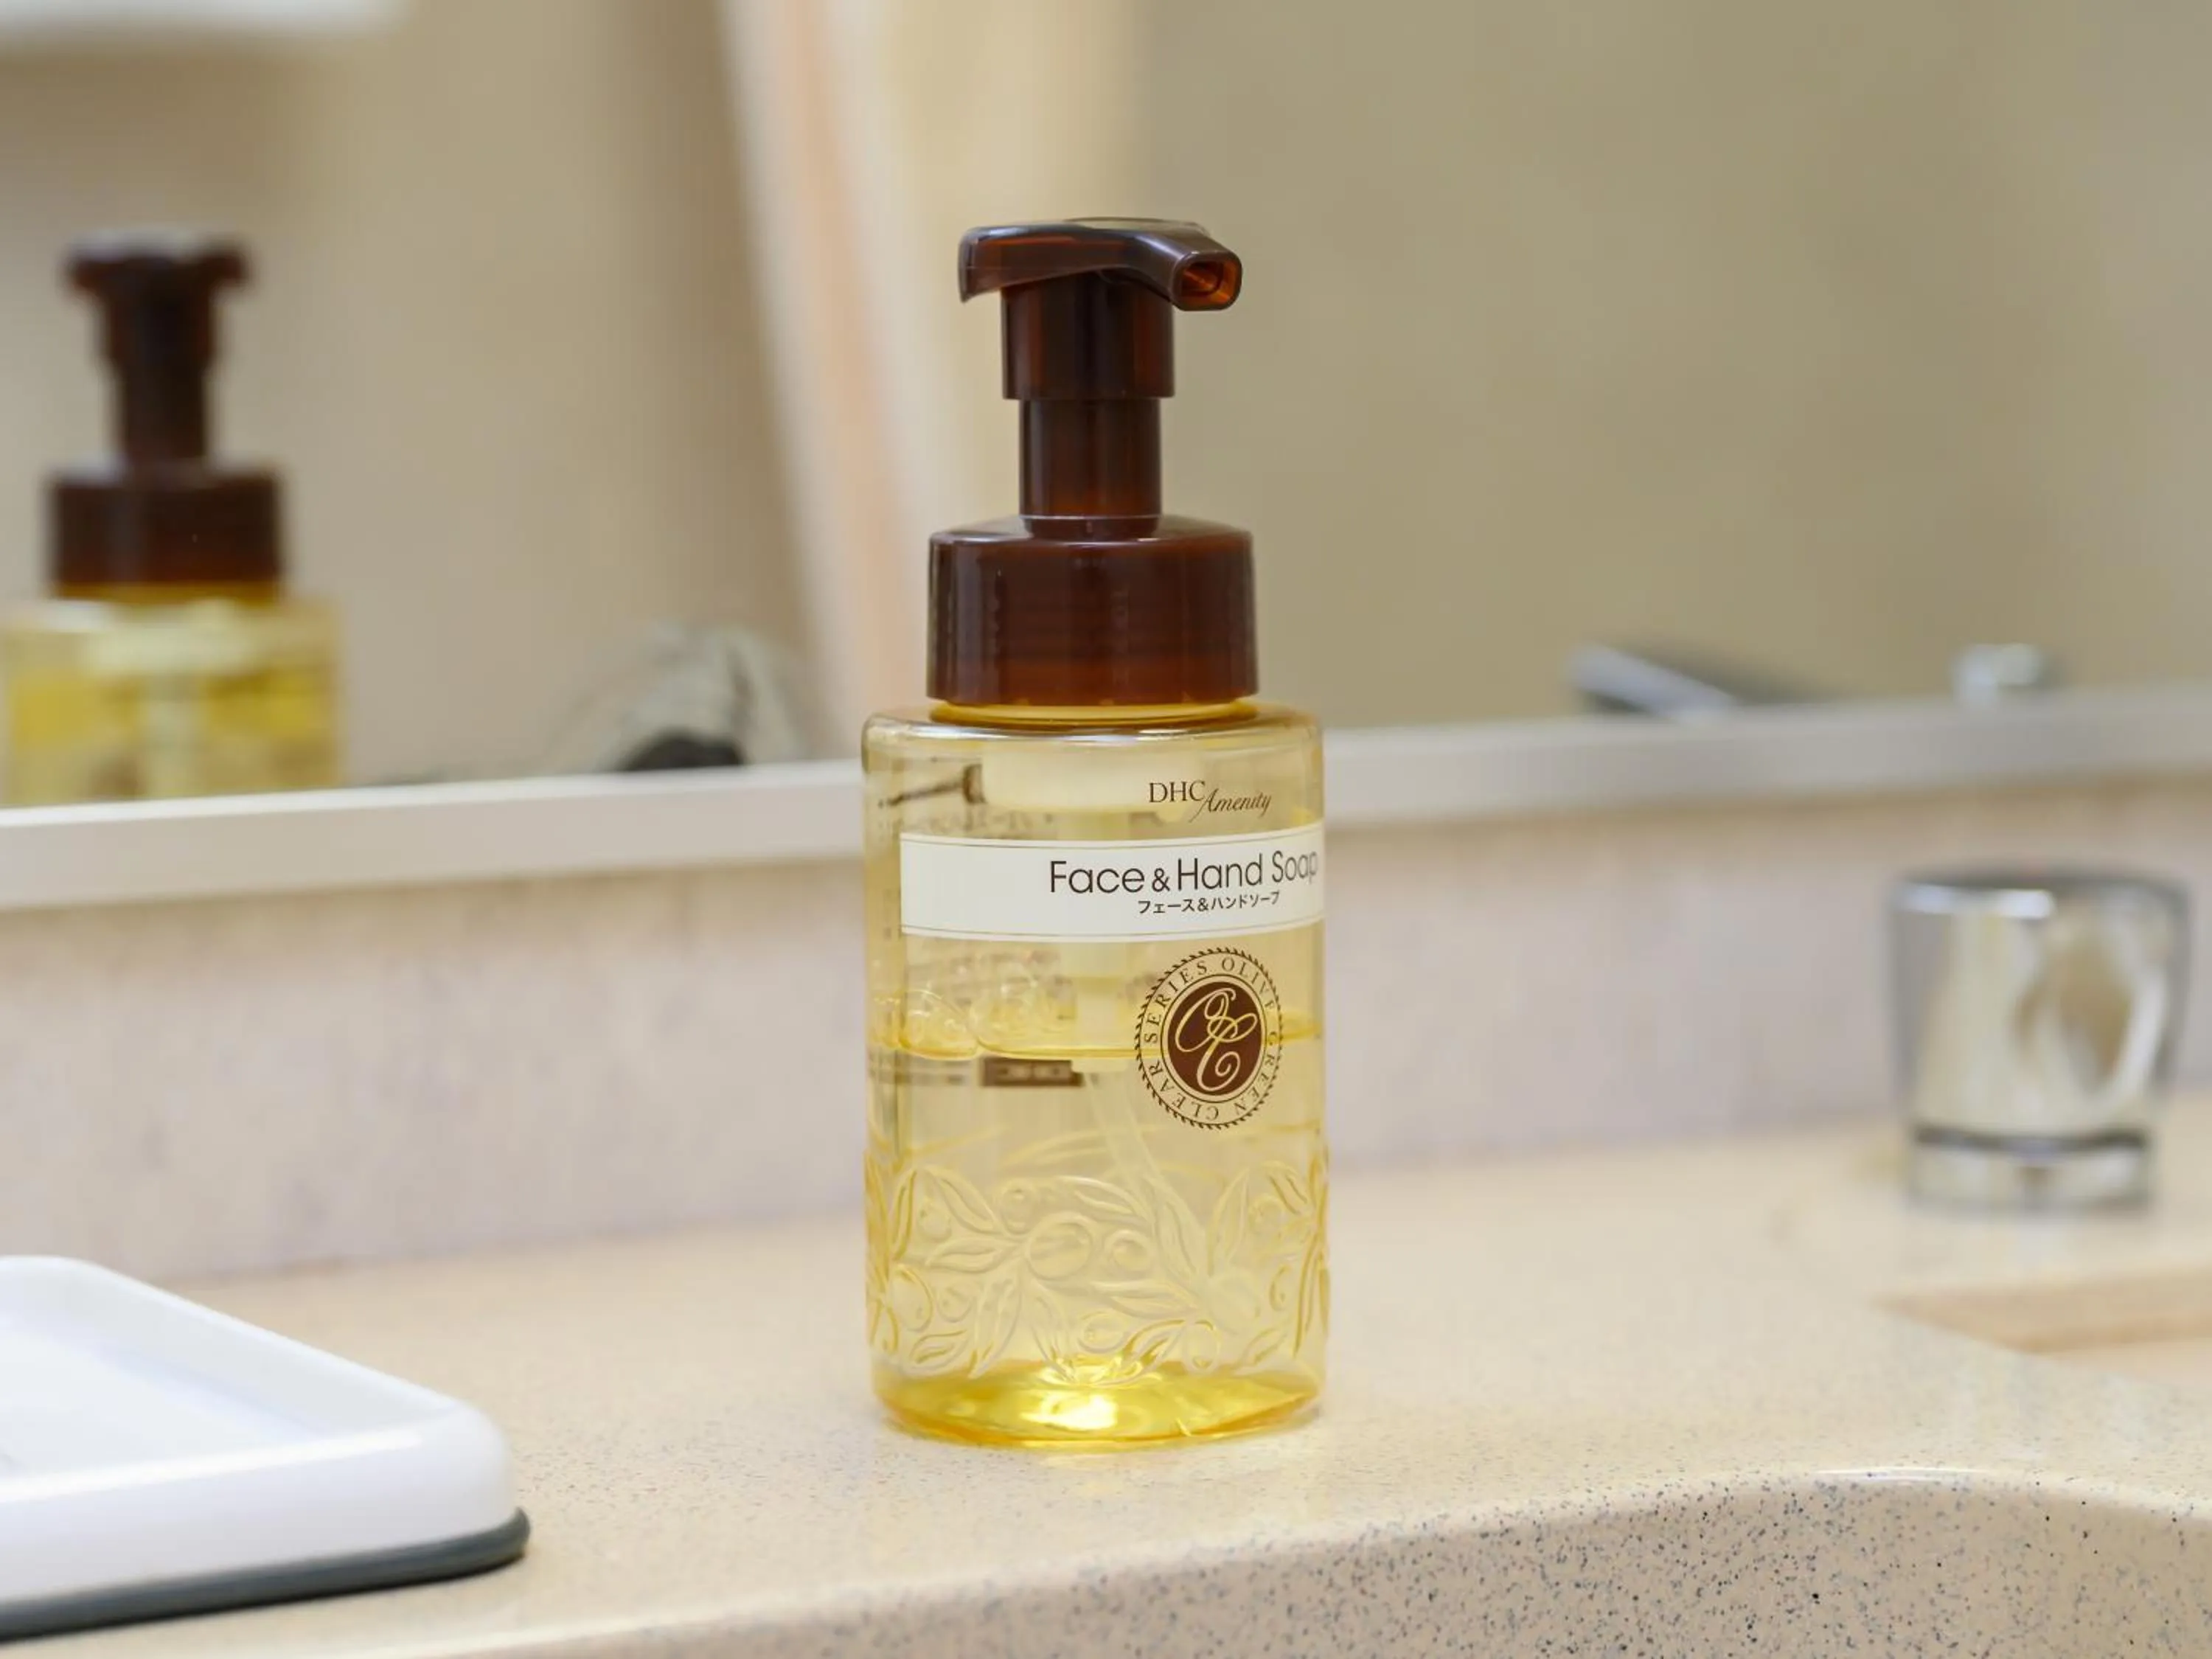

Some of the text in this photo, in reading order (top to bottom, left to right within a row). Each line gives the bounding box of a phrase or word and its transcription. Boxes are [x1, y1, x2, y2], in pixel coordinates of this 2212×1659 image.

[1149, 779, 1272, 823] DHC Amenity
[1051, 850, 1318, 894] Face & Hand Soap
[1144, 960, 1208, 1044] SERIES
[1221, 957, 1275, 1010] OLIVE
[1147, 1060, 1219, 1121] CLEAR
